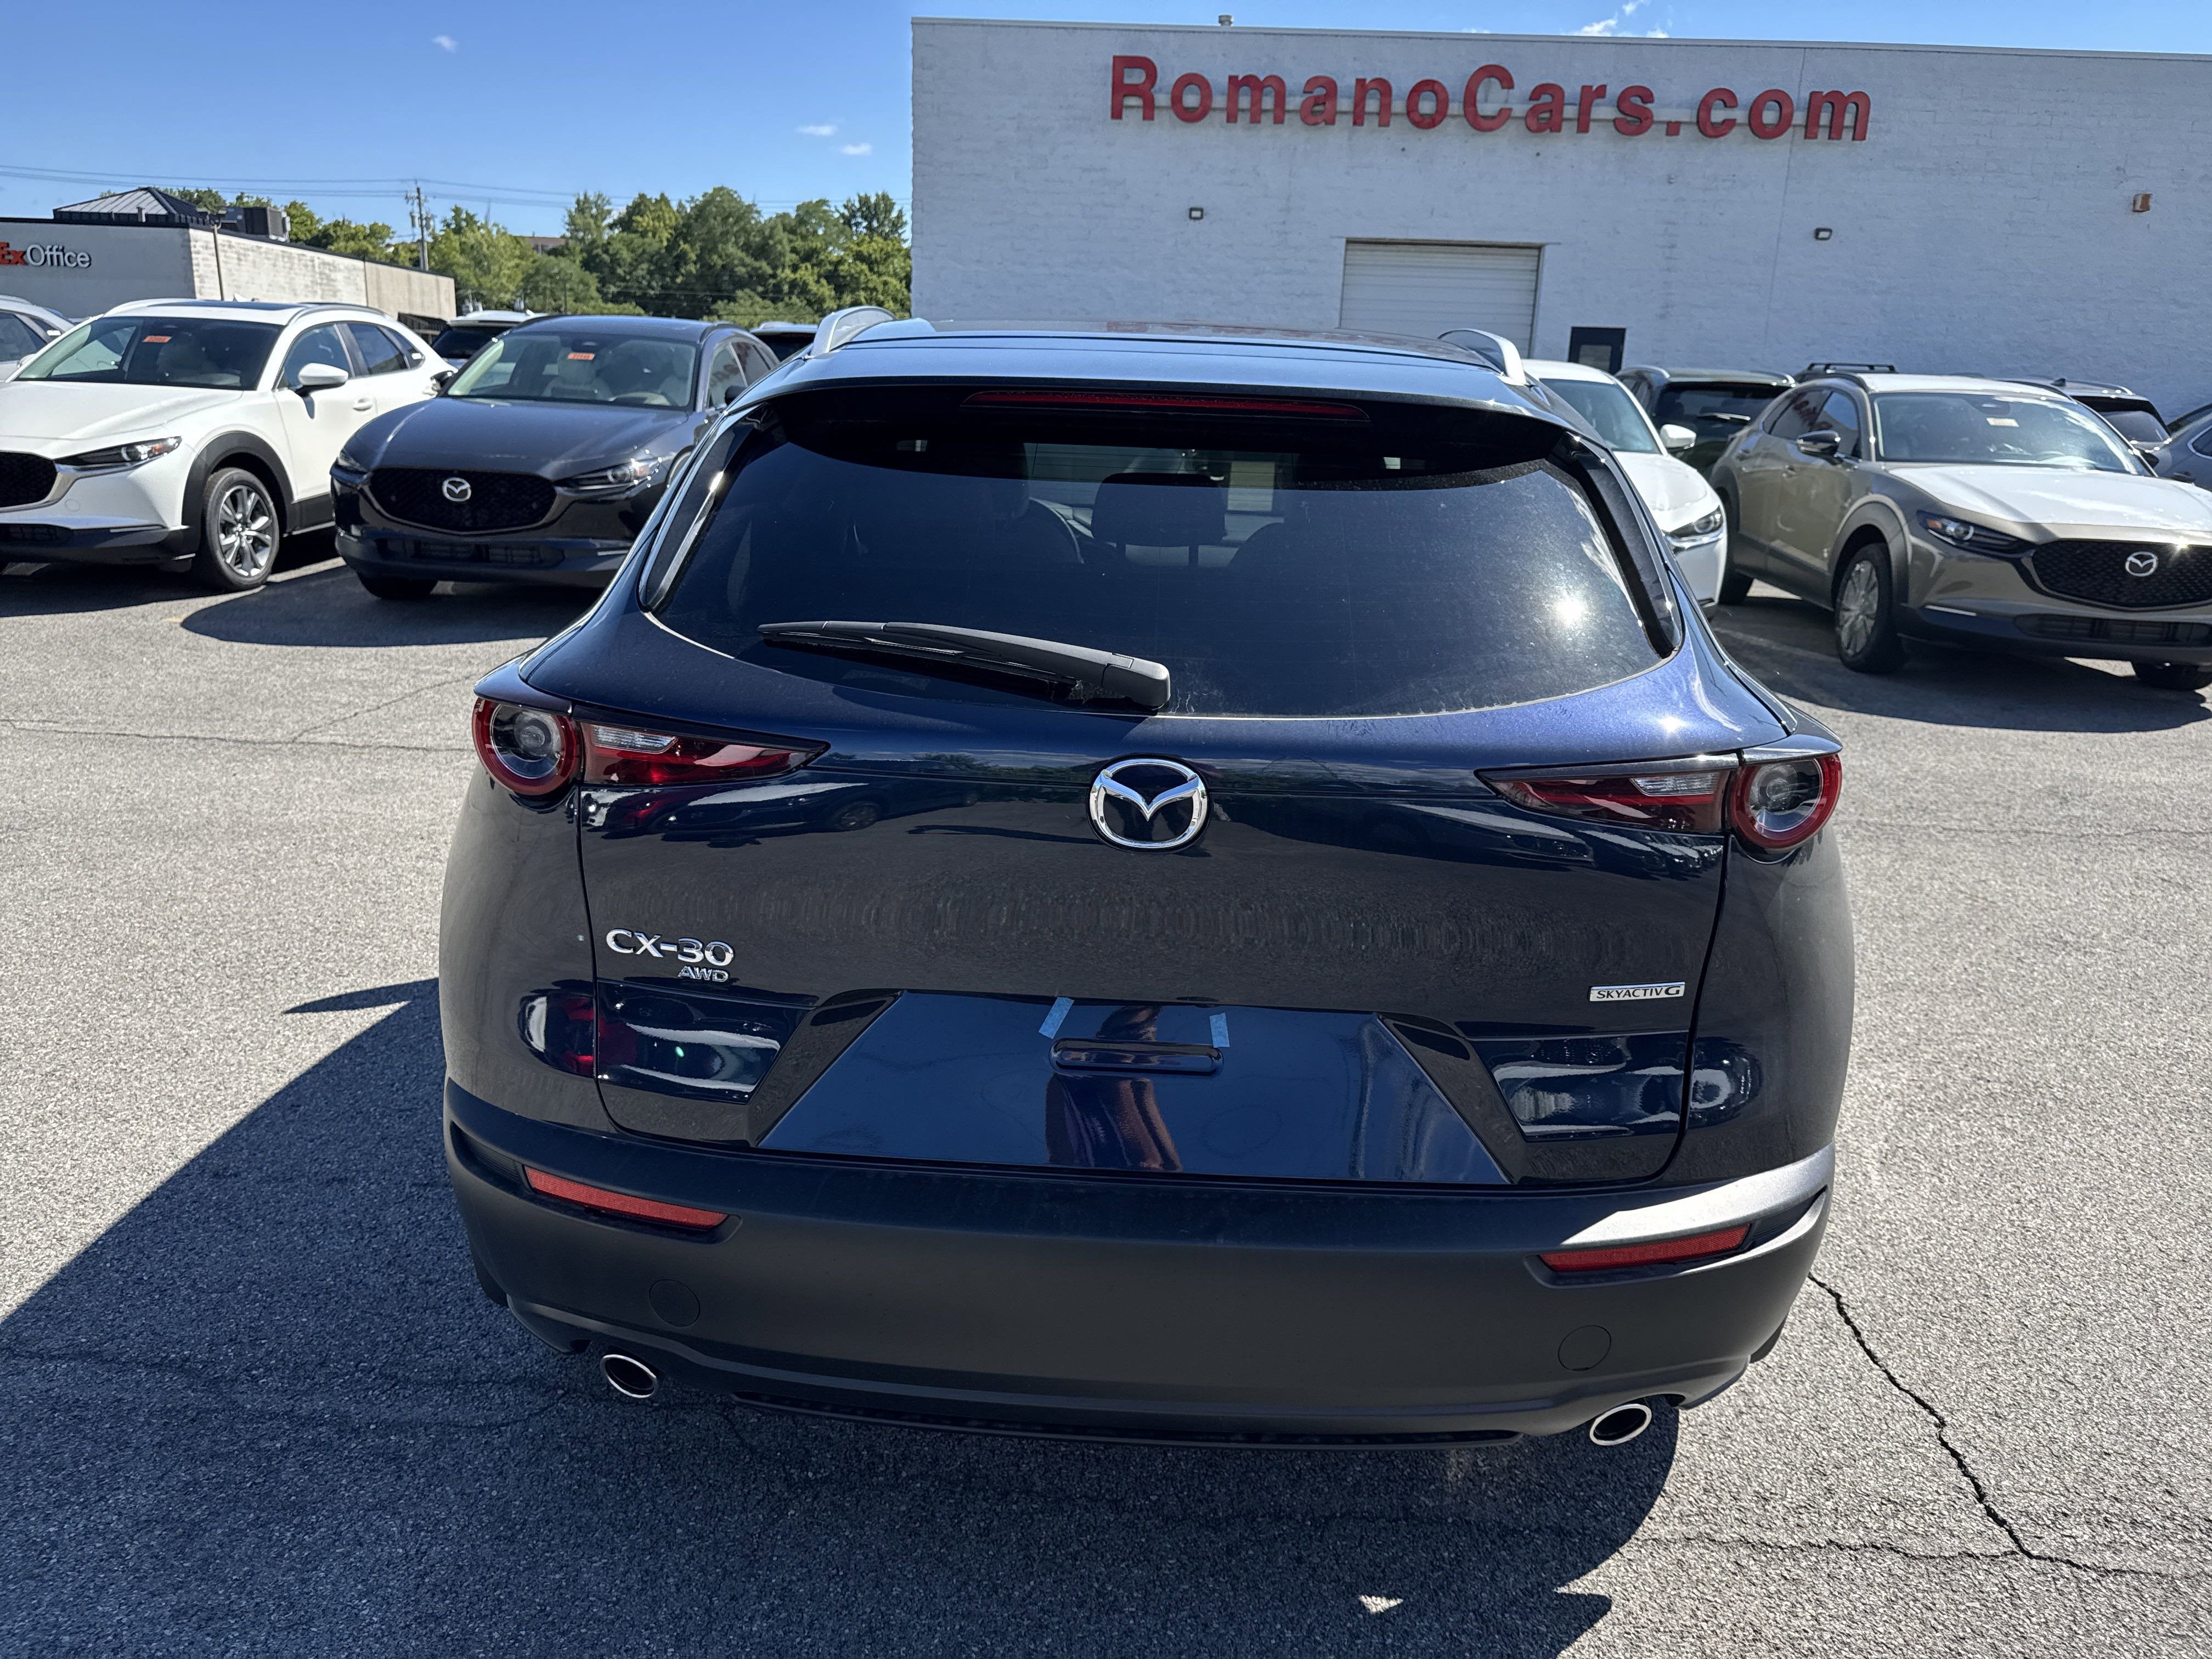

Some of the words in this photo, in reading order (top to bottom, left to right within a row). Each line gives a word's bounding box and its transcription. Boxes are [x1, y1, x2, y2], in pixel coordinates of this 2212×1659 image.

[1110, 54, 1871, 142] RomanoCars.com
[606, 928, 735, 967] CX-30
[677, 966, 729, 983] AWD
